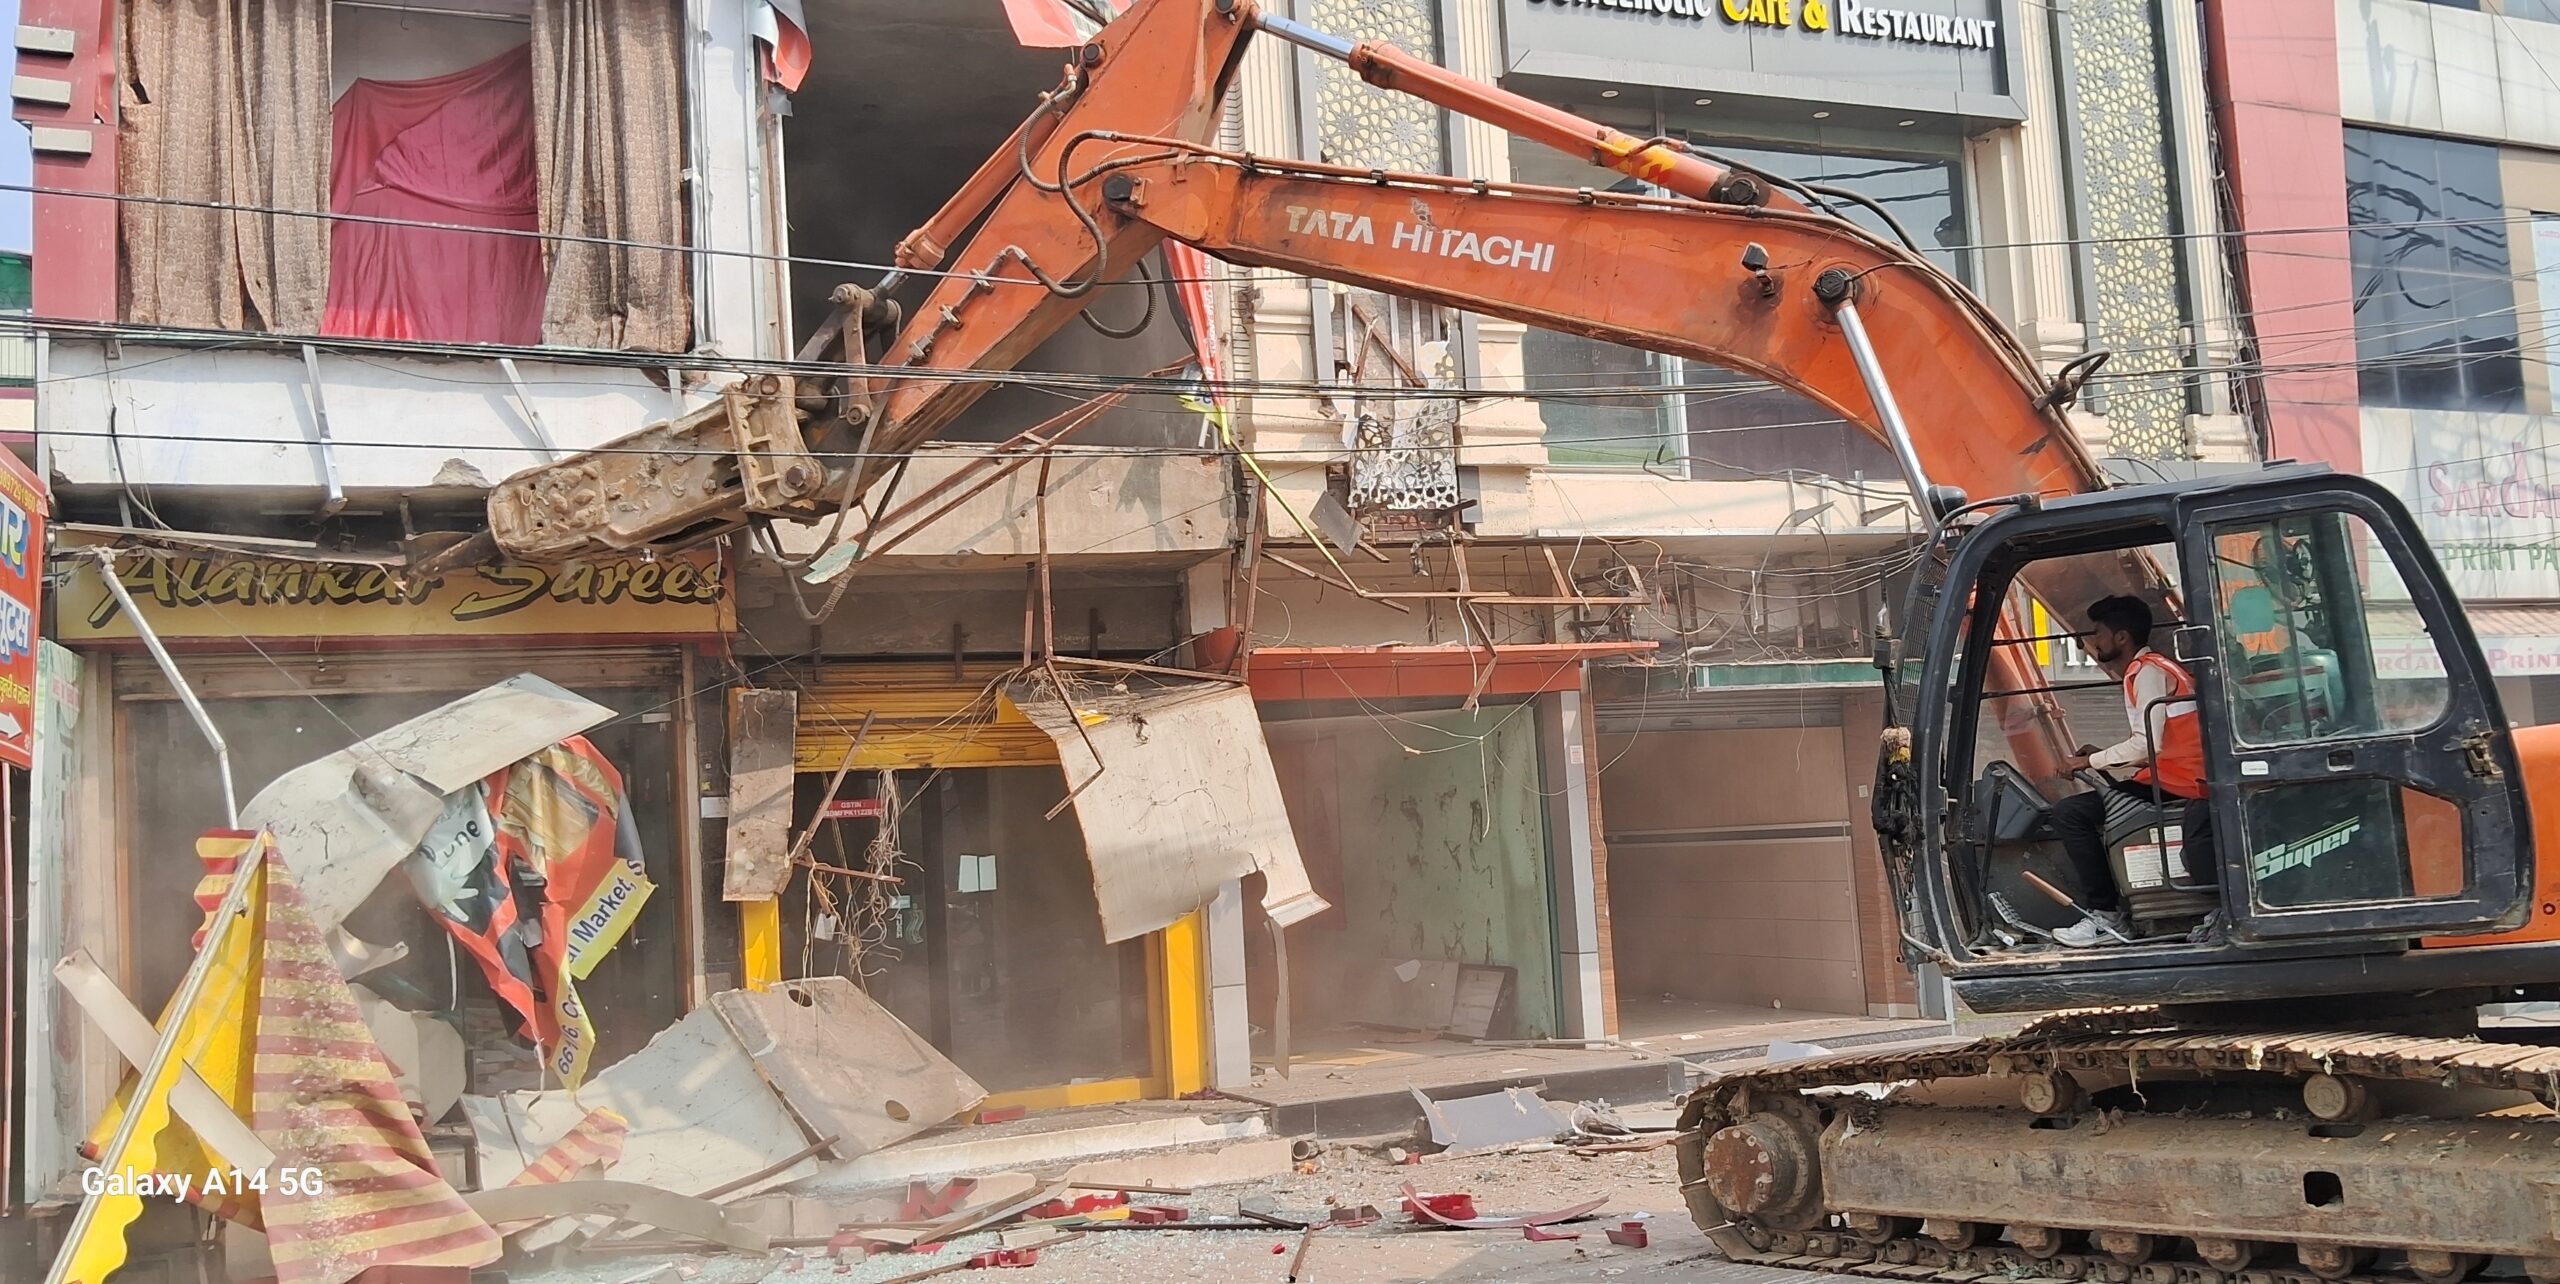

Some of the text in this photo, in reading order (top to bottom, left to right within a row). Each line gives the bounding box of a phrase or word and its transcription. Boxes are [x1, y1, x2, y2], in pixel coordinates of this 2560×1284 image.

[1285, 206, 1555, 272] TATA HITACHI
[87, 537, 727, 629] Alankar Sarees
[2443, 543, 2517, 570] PRINT
[2253, 823, 2361, 881] Super
[571, 876, 636, 943] Market,
